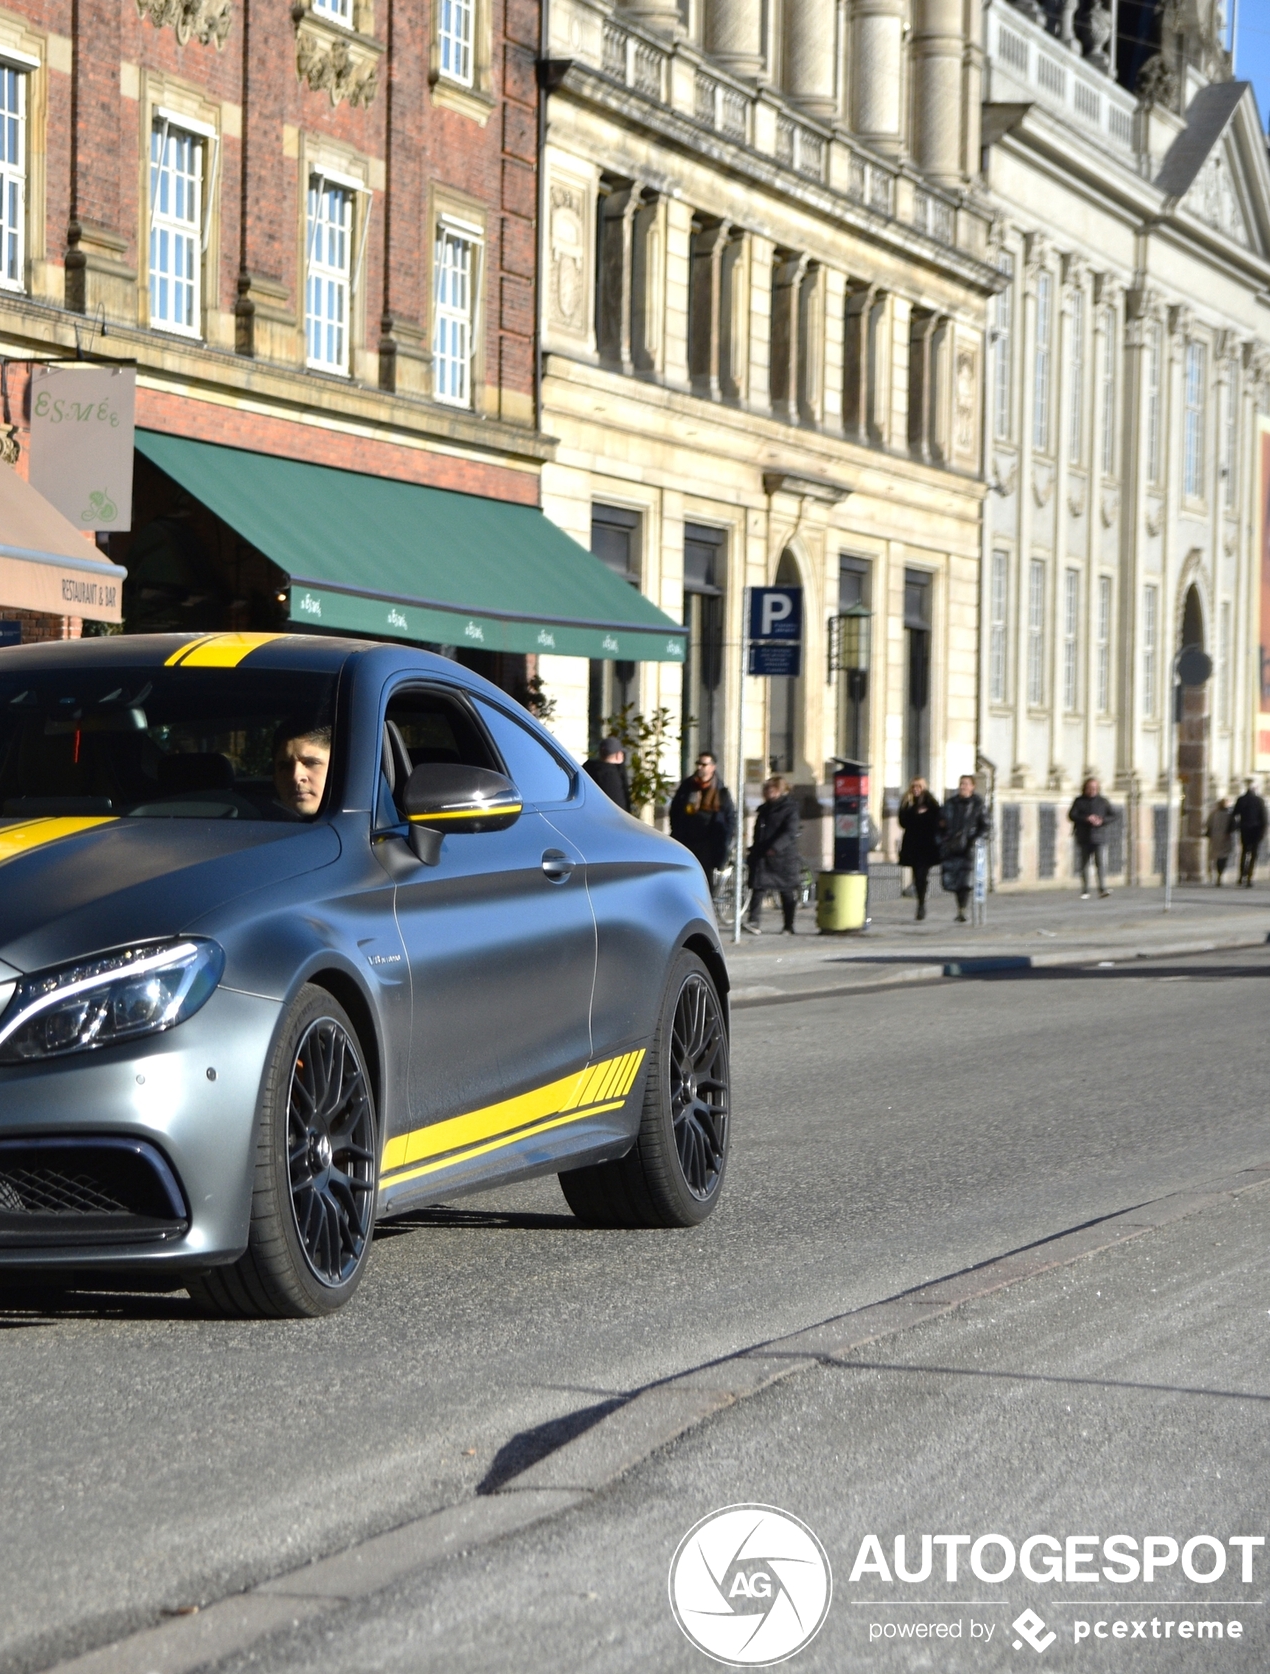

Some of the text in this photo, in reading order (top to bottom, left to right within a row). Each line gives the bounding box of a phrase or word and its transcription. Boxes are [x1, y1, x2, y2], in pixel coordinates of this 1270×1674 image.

[61, 579, 116, 608] RESTAURANT & BAR
[761, 593, 793, 635] P
